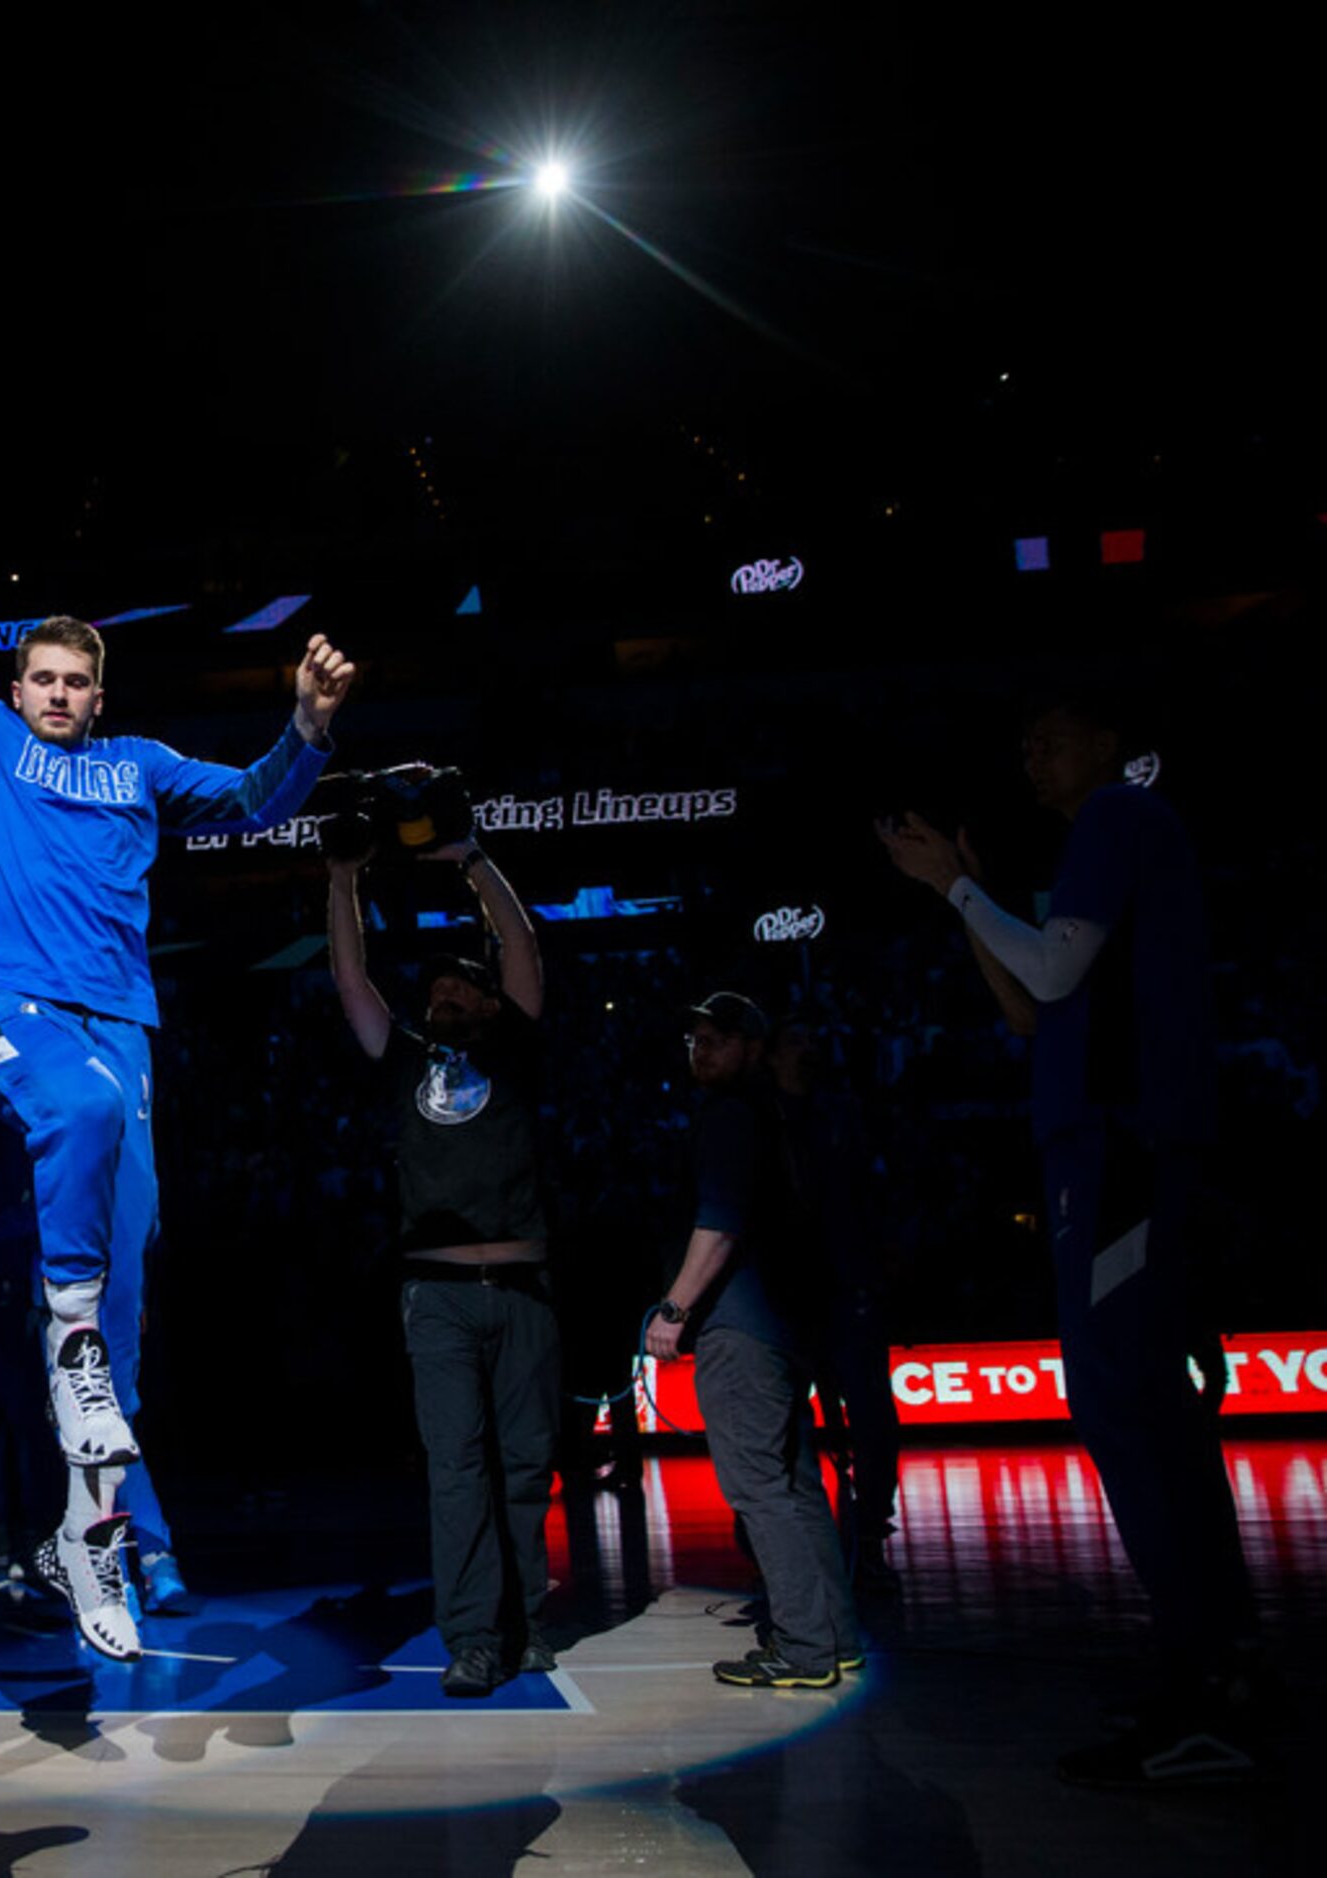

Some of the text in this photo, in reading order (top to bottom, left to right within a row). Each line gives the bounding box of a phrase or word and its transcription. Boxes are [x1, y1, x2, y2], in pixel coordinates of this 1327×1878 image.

[15, 734, 139, 804] DALLAS
[571, 786, 739, 826] Lineups
[978, 1365, 1038, 1394] TO
